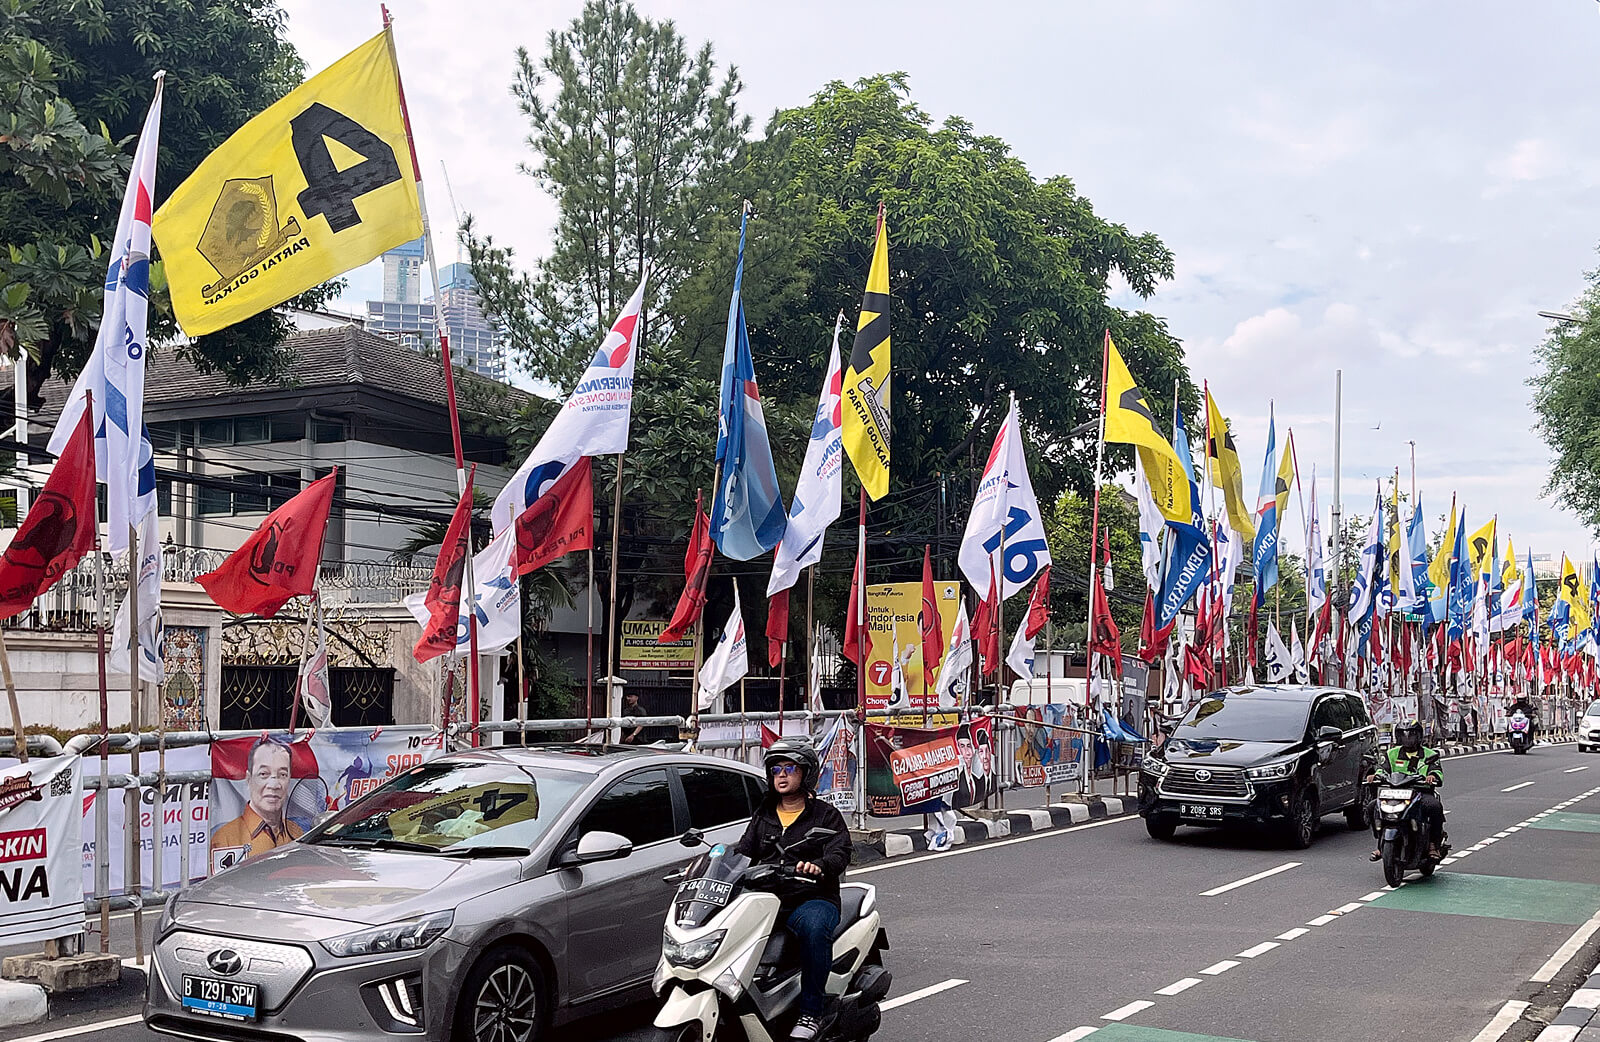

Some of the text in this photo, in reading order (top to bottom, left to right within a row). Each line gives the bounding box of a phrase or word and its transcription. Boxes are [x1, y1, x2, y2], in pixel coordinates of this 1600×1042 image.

[846, 388, 891, 470] PARTAI GOLKAR
[868, 622, 893, 633] Maju
[875, 667, 888, 684] 7
[1181, 805, 1186, 814] B
[184, 978, 255, 1006] B 1291 SPW
